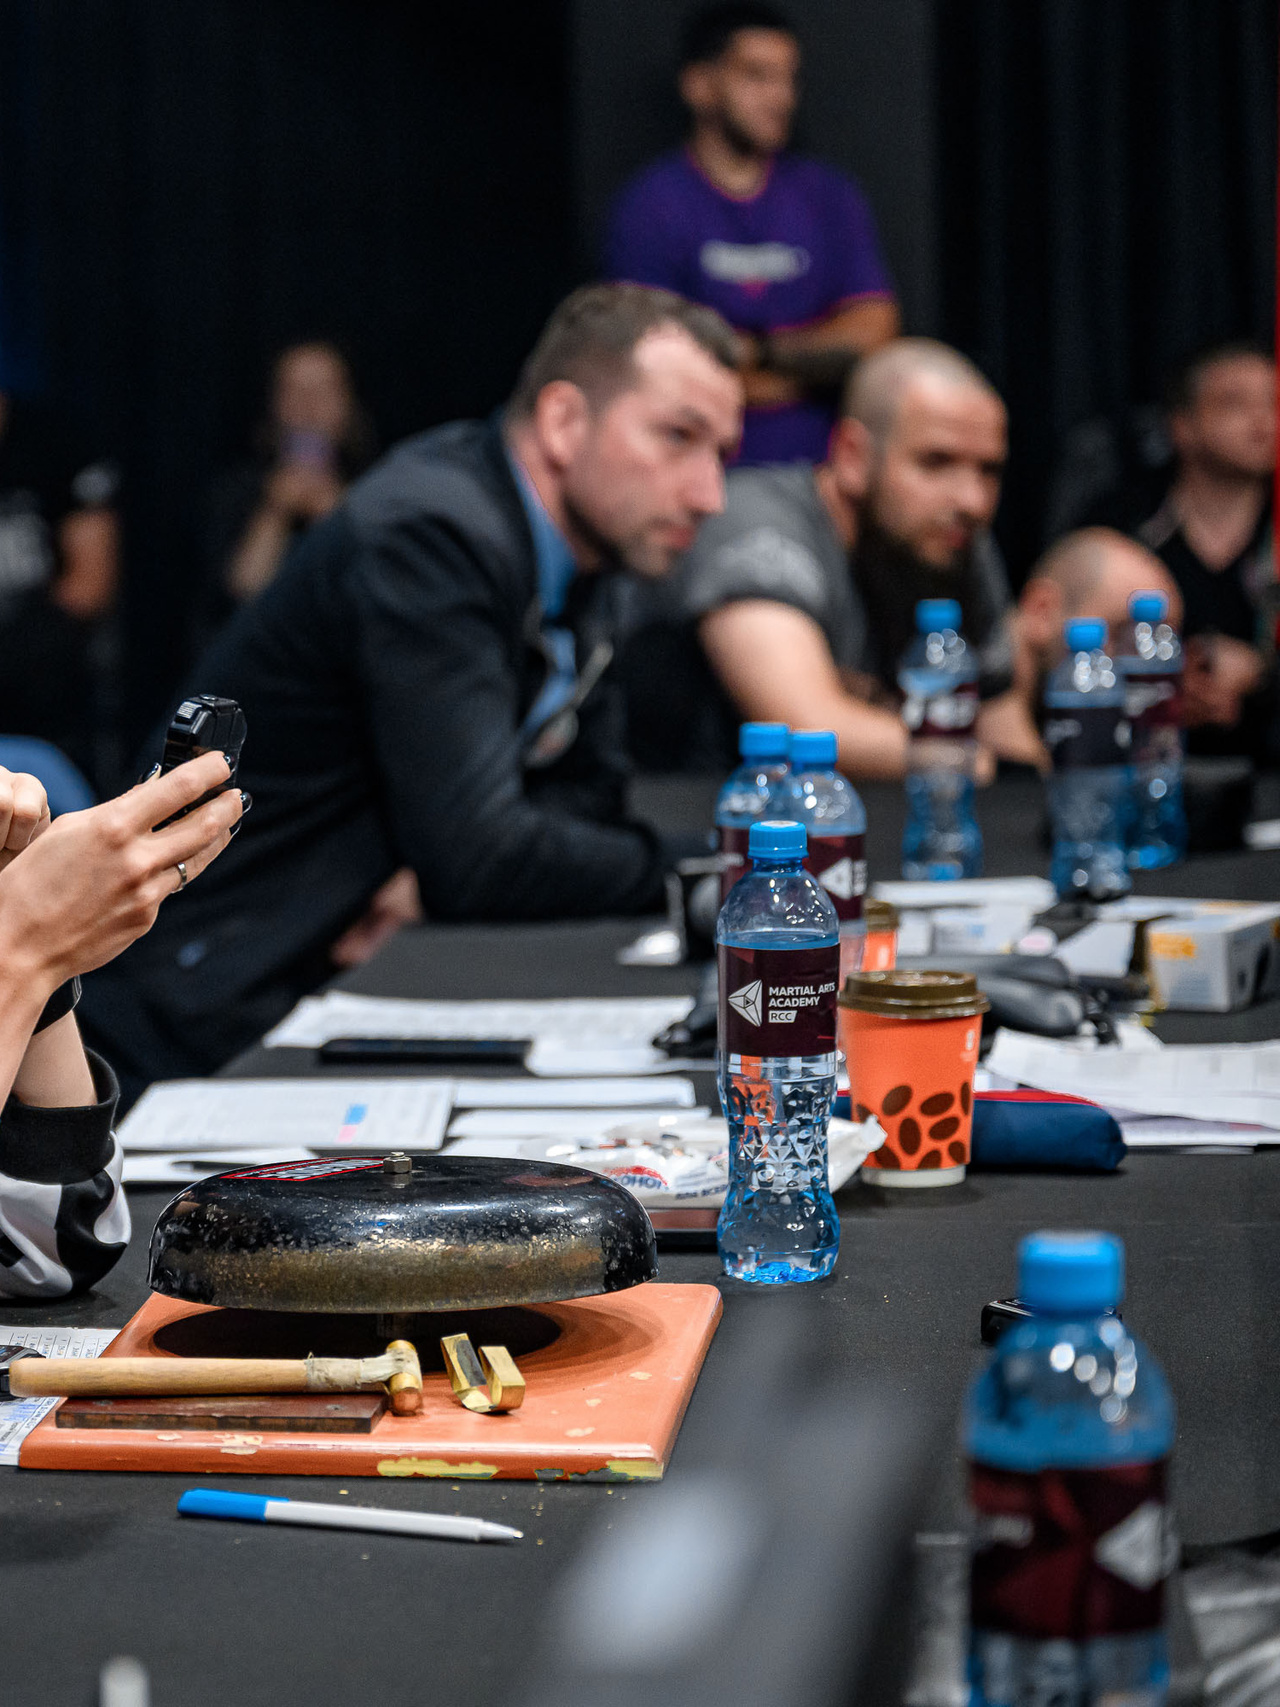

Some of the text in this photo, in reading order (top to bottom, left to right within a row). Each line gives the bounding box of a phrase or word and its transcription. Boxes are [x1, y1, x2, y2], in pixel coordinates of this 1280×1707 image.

[769, 982, 835, 996] MARTIAL ARTS
[769, 996, 820, 1007] ACADEMY
[770, 1012, 793, 1021] RCC
